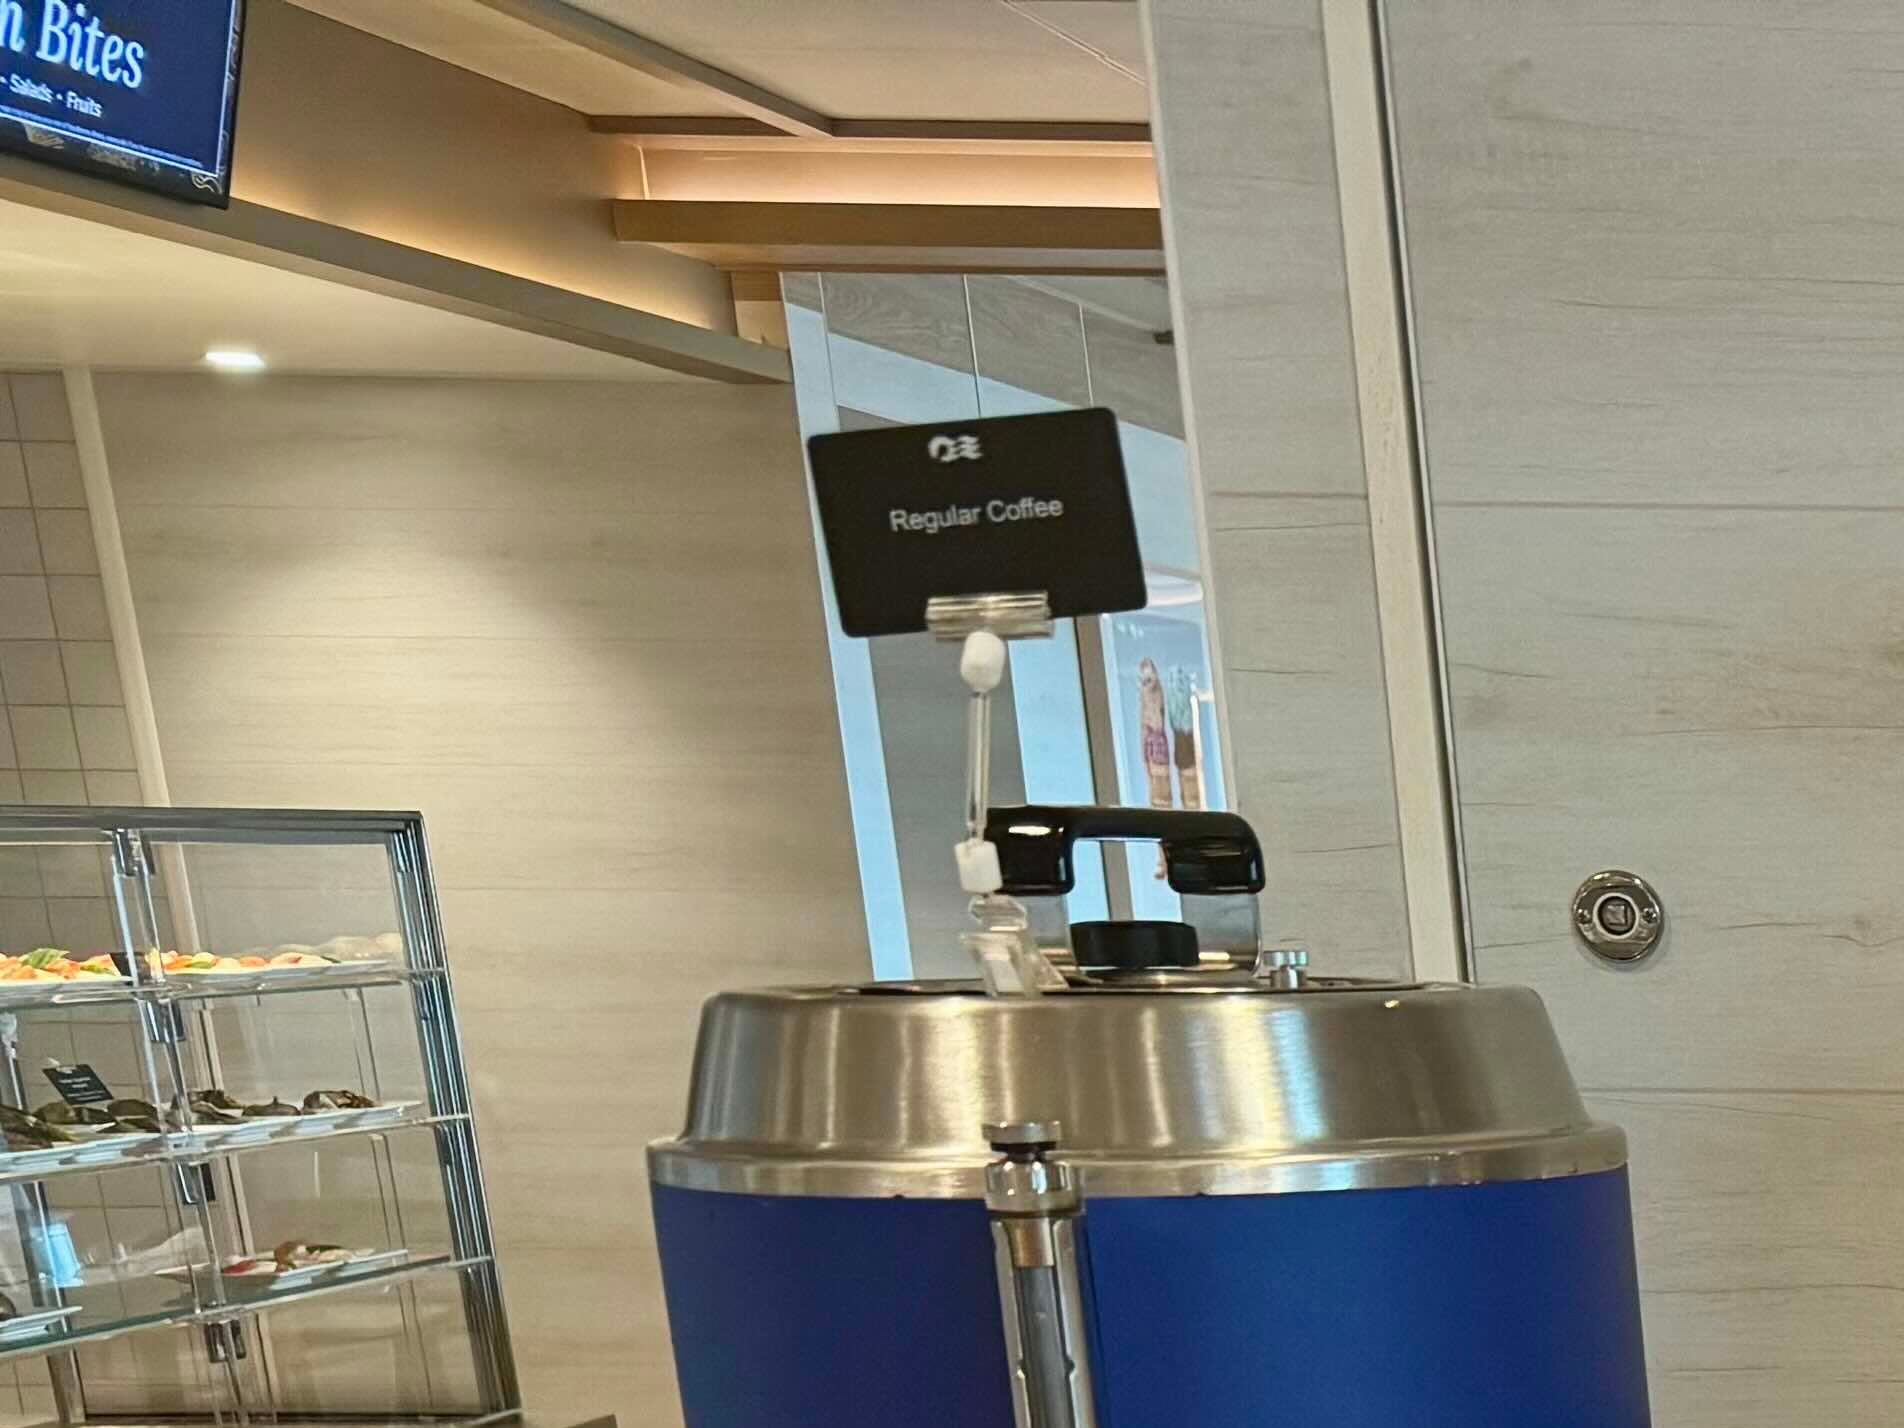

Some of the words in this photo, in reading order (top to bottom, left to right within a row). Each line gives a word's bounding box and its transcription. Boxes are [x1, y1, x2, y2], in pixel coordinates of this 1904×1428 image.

[36, 0, 144, 89] Bites
[889, 504, 980, 534] Regular
[985, 497, 1064, 523] Coffee
